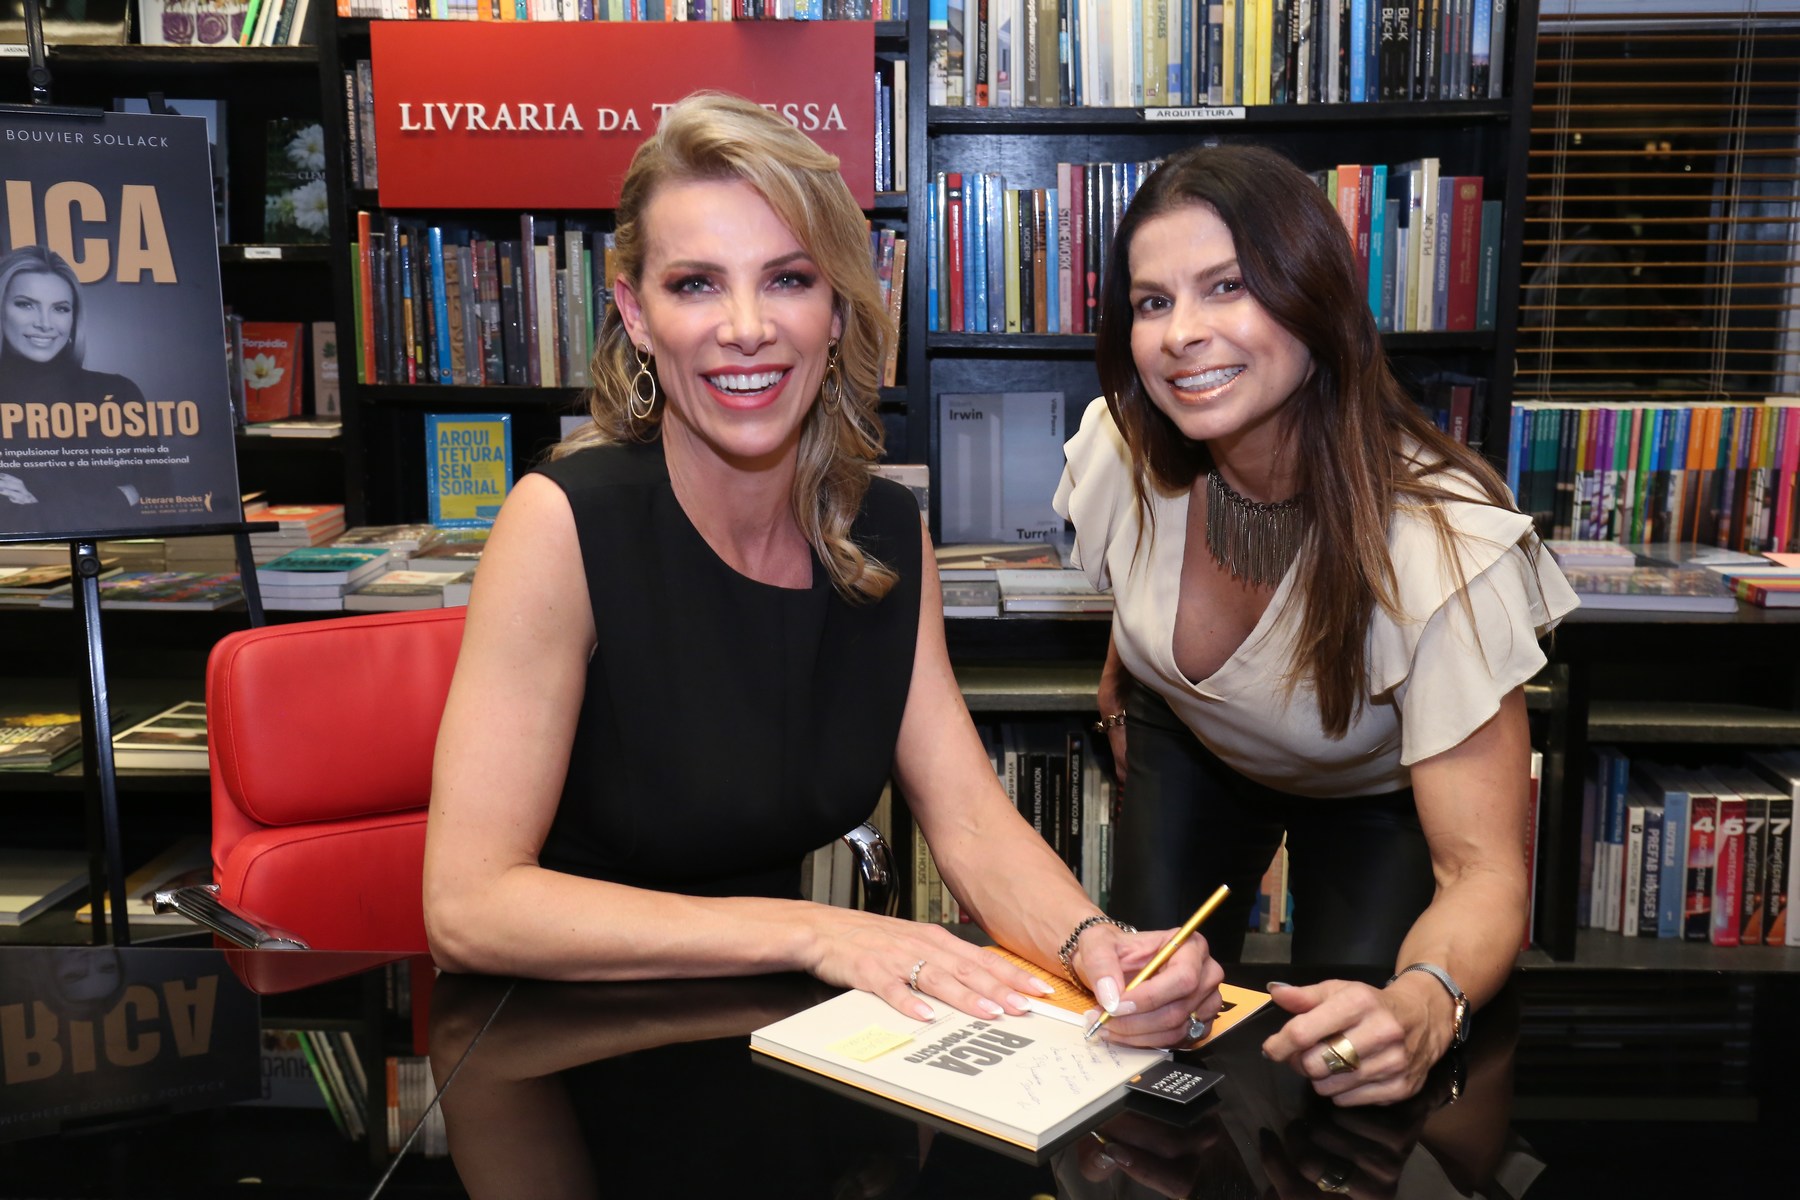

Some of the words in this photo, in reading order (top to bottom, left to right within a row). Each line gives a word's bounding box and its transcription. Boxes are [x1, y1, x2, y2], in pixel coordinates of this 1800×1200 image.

[1381, 7, 1394, 41] BLACK
[1397, 7, 1410, 41] BLACK
[345, 75, 353, 98] SALTO
[347, 99, 354, 110] NO
[1156, 109, 1234, 118] ARQUITETURA
[348, 111, 356, 141] ESCURO
[399, 103, 583, 132] LIVRARIA
[598, 108, 641, 132] DA
[6, 129, 84, 144] BOUVIER
[93, 133, 169, 148] SOLLACK
[1440, 212, 1449, 234] CAPE
[1023, 227, 1031, 262] MODERN
[1058, 208, 1071, 270] STONEWORK
[1440, 236, 1448, 254] COD
[1437, 256, 1447, 292] MODERN
[1, 394, 200, 439] PROPÓSITO
[949, 409, 983, 421] Irwin
[1050, 398, 1058, 414] Villa
[440, 430, 490, 447] ARQUI
[5, 447, 60, 457] impulsionar
[61, 446, 89, 456] lucros
[91, 446, 114, 455] reais
[116, 447, 132, 456] por
[133, 445, 156, 454] meio
[156, 445, 170, 453] da
[23, 458, 67, 468] assertiva
[77, 458, 90, 467] da
[91, 456, 144, 468] inteligência
[145, 455, 190, 465] emocional
[440, 446, 504, 463] TETURA
[440, 463, 473, 480] SEN
[441, 479, 500, 497] SORIAL
[140, 496, 175, 505] Literare
[176, 495, 203, 503] Books
[1070, 754, 1079, 783] HOUSES
[1034, 767, 1042, 813] RENOVATION
[1070, 784, 1080, 817] COUNTRY
[1615, 794, 1623, 814] EURO
[1070, 818, 1080, 835] NEW
[1614, 815, 1622, 843] HOTELS
[1630, 824, 1642, 834] 5
[1692, 816, 1715, 833] 4
[1744, 817, 1765, 834] 7
[1769, 817, 1791, 836] 7
[1646, 828, 1660, 872] PREFAB
[917, 857, 927, 886] HOUSE
[1696, 835, 1708, 890] ARCHITECTURE
[1726, 837, 1737, 894] ARCHITECTURE
[1747, 836, 1759, 893] ARCHITECTURE
[1772, 836, 1784, 893] ARCHITECTURE
[1642, 873, 1657, 918] HOUSES
[966, 1020, 992, 1031] DE
[903, 1028, 974, 1064] PROPÓSITO
[925, 1028, 1035, 1077] RICA
[1150, 1070, 1183, 1090] SOLLACK
[1161, 1072, 1193, 1093] BOUVIER
[1172, 1075, 1203, 1096] MICHELE
